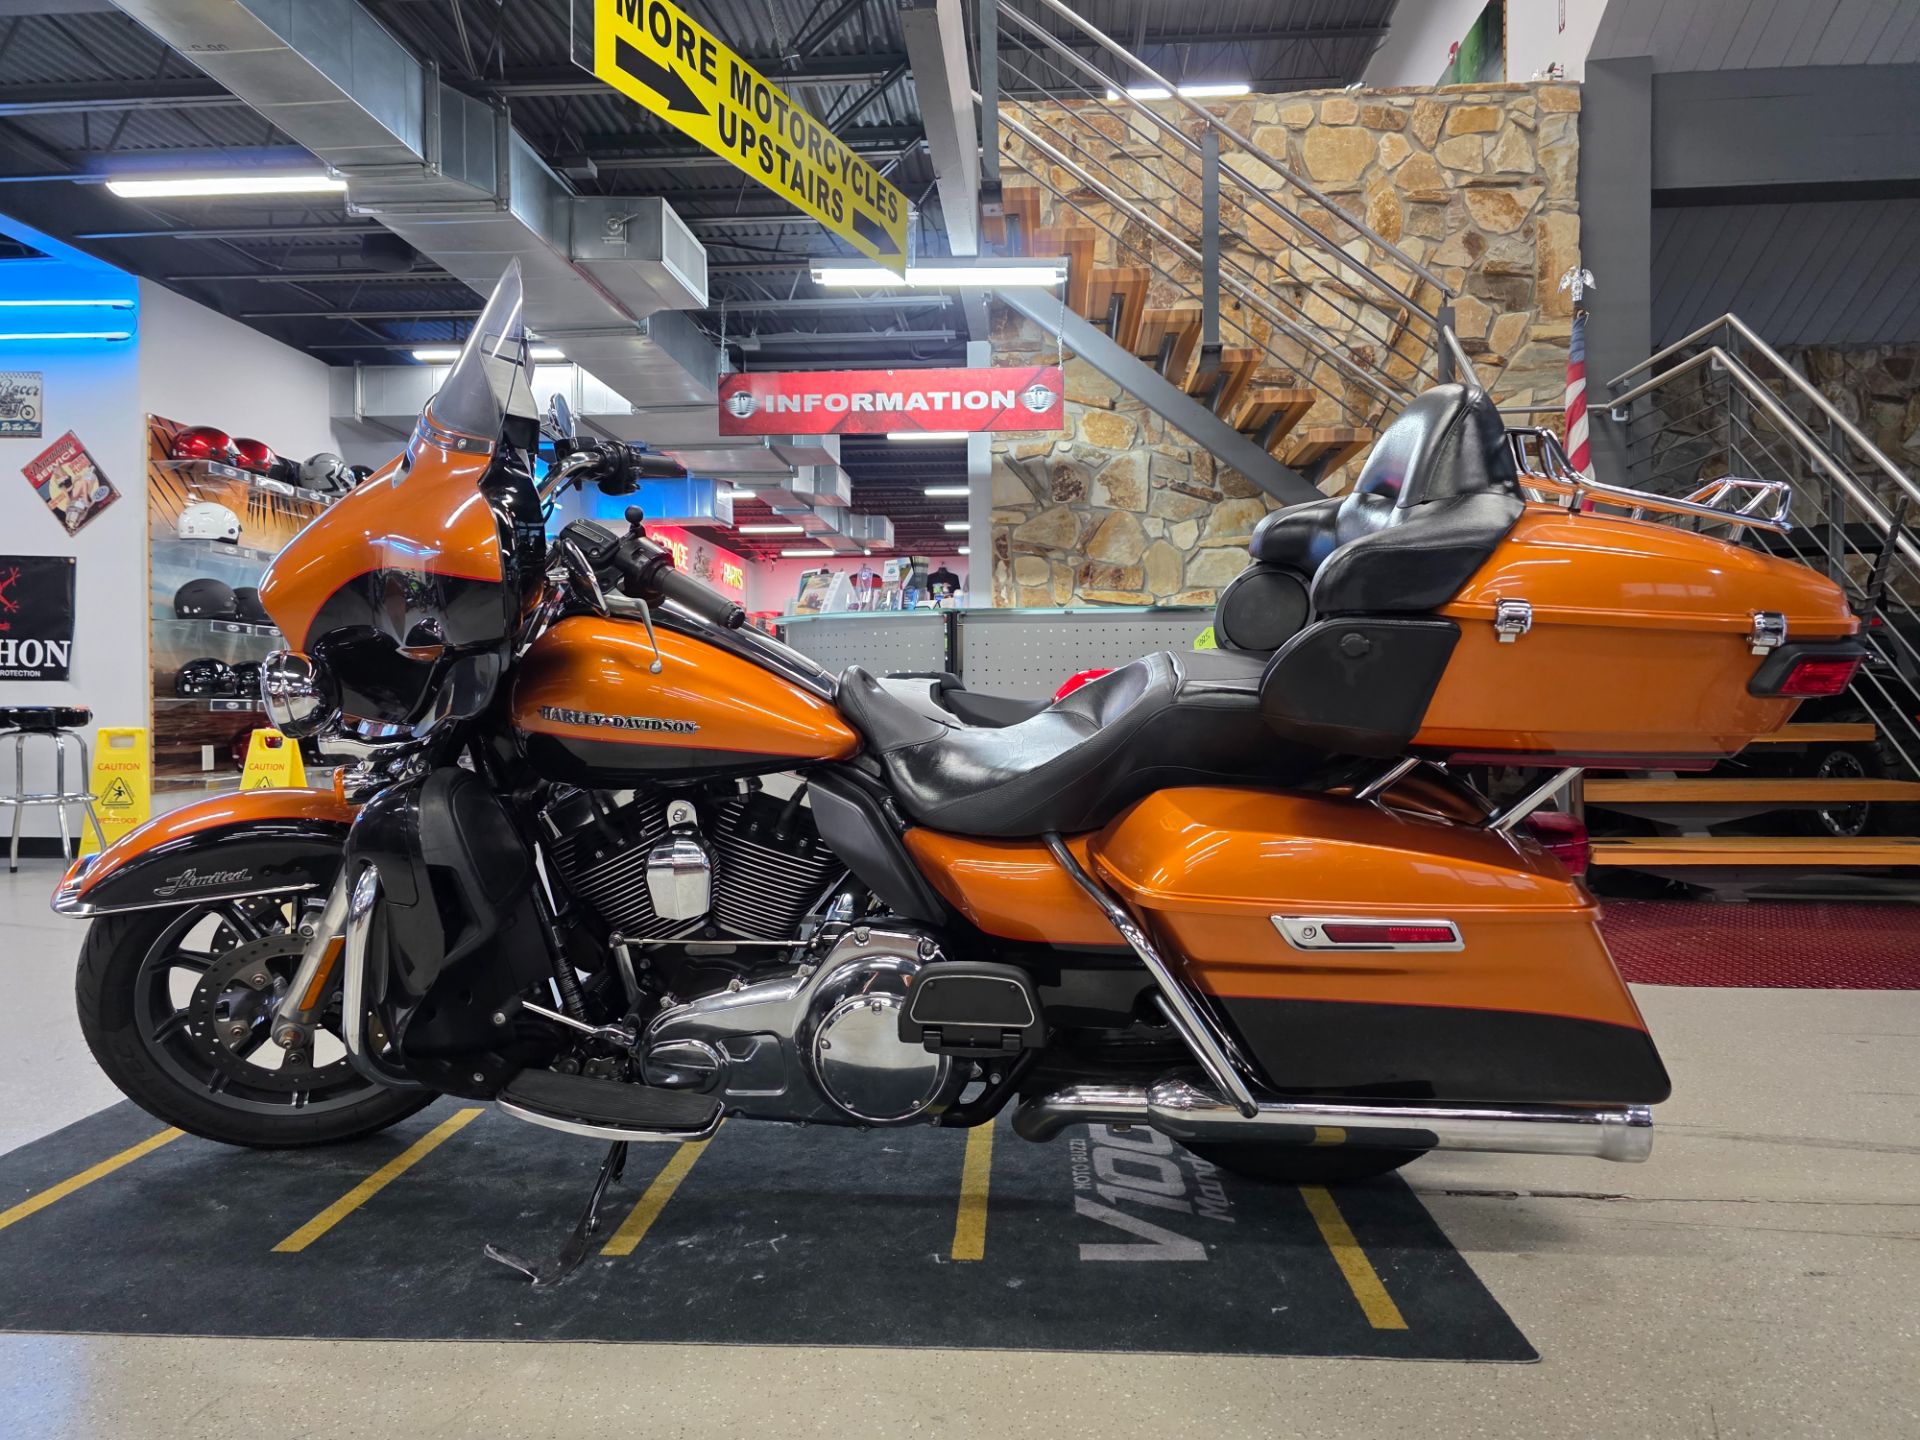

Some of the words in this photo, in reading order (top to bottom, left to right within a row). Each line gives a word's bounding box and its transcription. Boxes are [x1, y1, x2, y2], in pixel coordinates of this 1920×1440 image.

[616, 0, 717, 86] MORE
[730, 60, 898, 223] MOTORCYCLES
[718, 102, 844, 223] UPSTAIRS
[765, 390, 1016, 413] INFORMATION
[35, 447, 77, 482] SERVICE
[97, 763, 140, 771] CAUTION
[248, 763, 285, 771] CAUTION
[153, 867, 253, 897] Limited
[1069, 1138, 1089, 1163] GUZZI
[1071, 1164, 1092, 1190] MOTO
